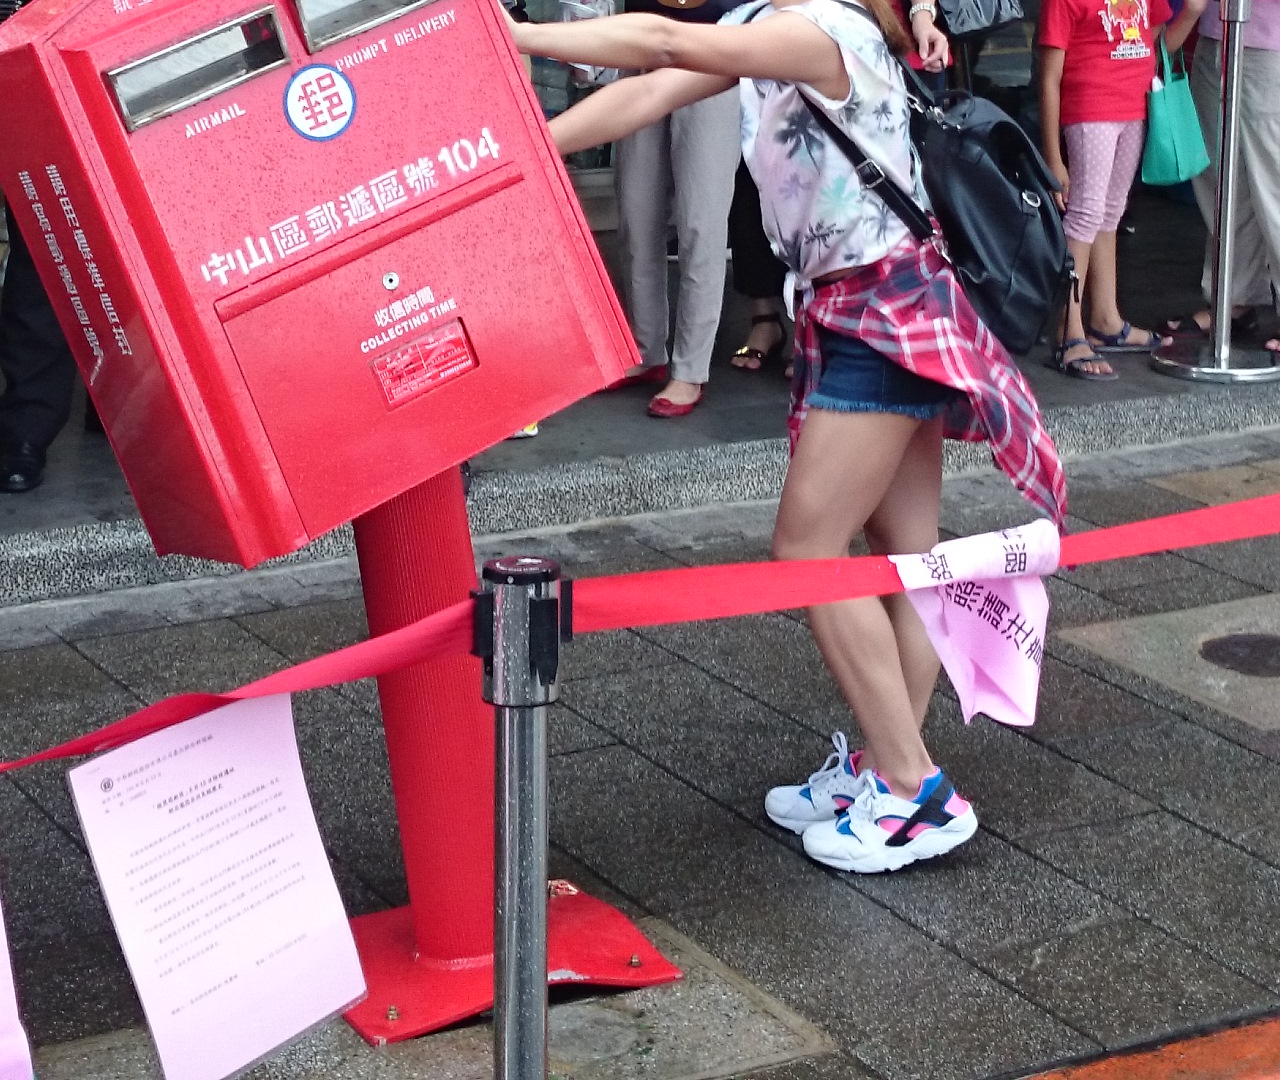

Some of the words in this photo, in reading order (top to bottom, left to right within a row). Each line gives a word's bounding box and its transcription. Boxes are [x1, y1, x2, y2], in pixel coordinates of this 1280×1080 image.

[335, 38, 389, 72] PROMPT
[394, 9, 457, 48] DELIVERY
[184, 103, 246, 138] AIRMAIL
[200, 157, 439, 286] 中山區郵遞區號
[438, 126, 500, 180] 104
[360, 314, 430, 354] COLLECTING
[429, 297, 457, 321] TIME
[373, 286, 435, 328] 收信時間
